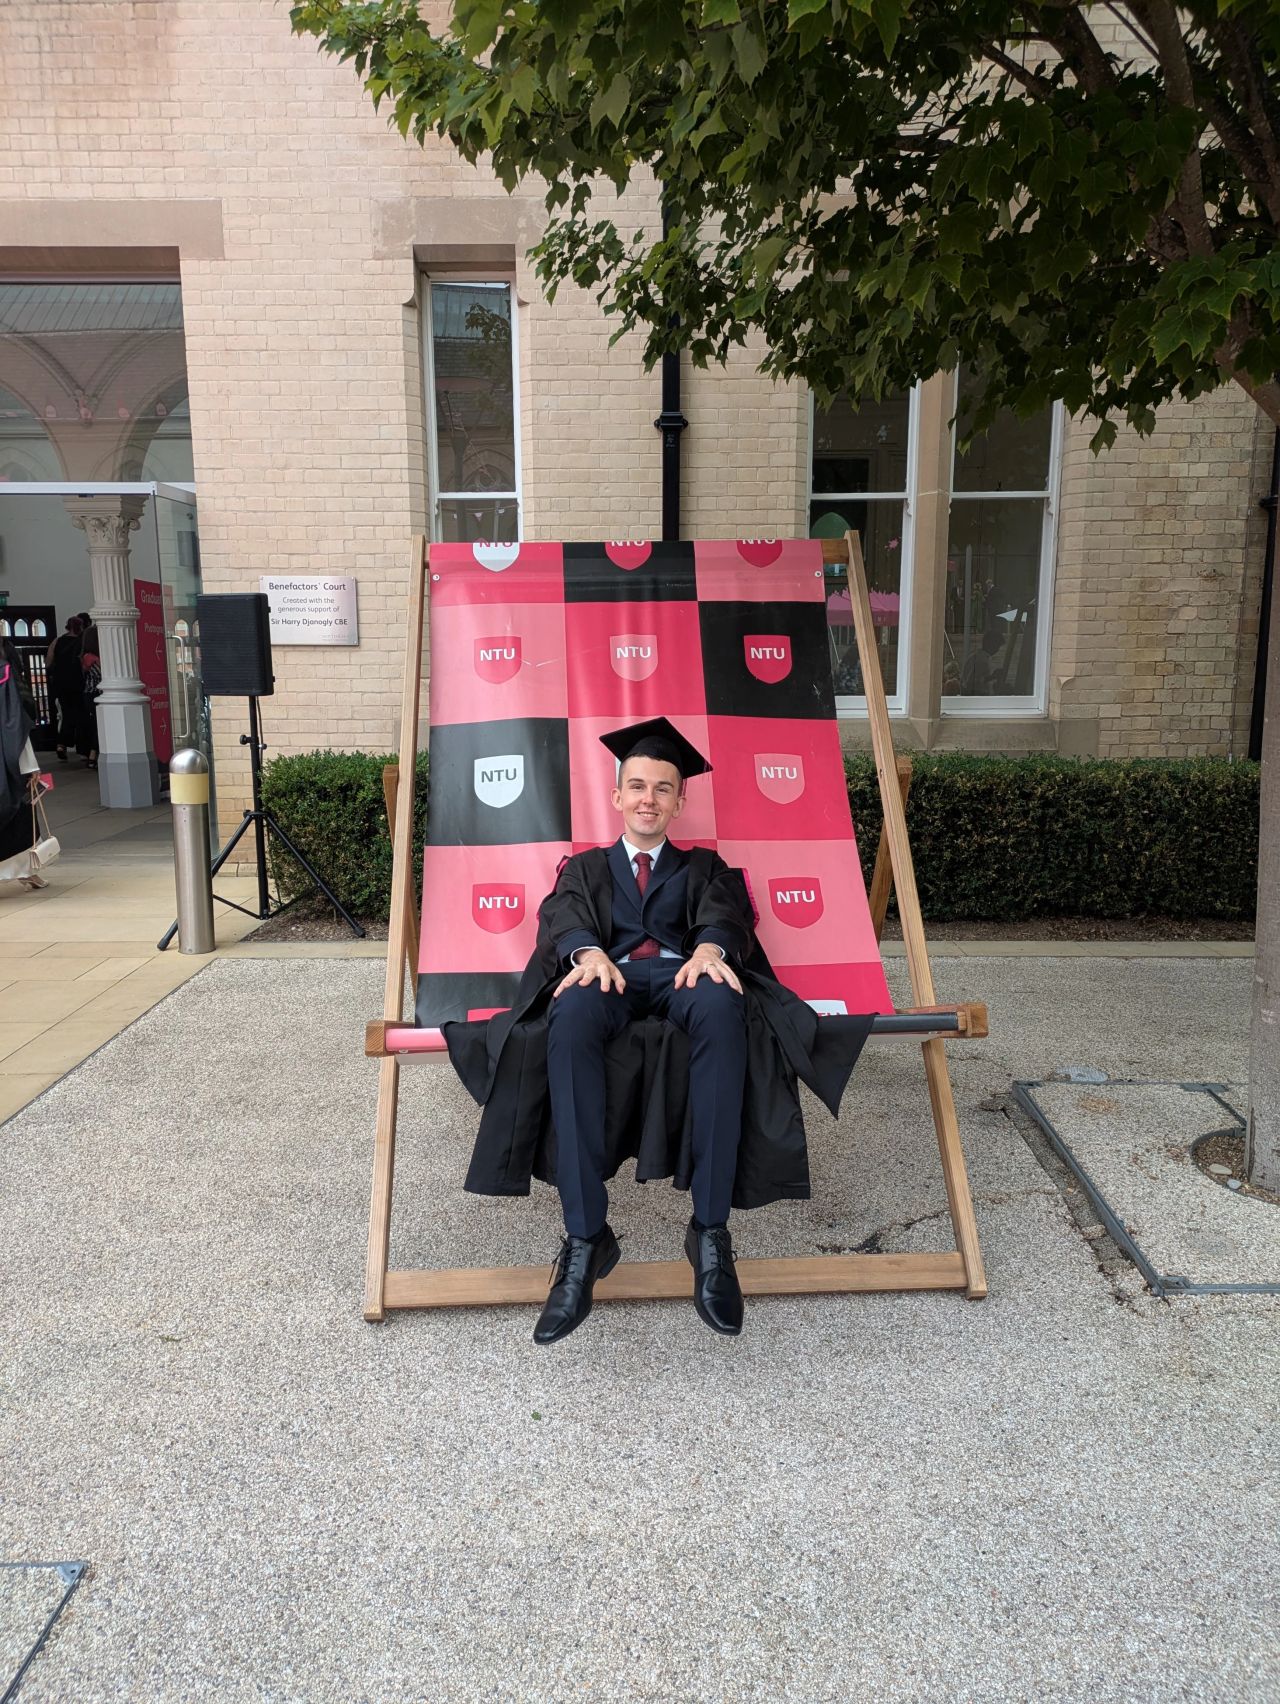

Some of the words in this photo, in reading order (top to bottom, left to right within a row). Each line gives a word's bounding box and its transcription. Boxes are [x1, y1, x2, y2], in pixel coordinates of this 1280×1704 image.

[323, 582, 346, 591] Court
[283, 596, 307, 604] Created
[309, 596, 322, 604] with
[324, 596, 334, 604] the
[277, 606, 306, 614] generous
[307, 606, 331, 614] support
[282, 618, 300, 627] Harry
[302, 618, 333, 627] Djanogly
[480, 648, 516, 661] NTU
[616, 646, 652, 659] NTU
[750, 647, 786, 660] NTU
[480, 767, 518, 783] NTU
[761, 766, 798, 780] NTU
[776, 889, 816, 904] NTU
[478, 896, 520, 911] NTU
